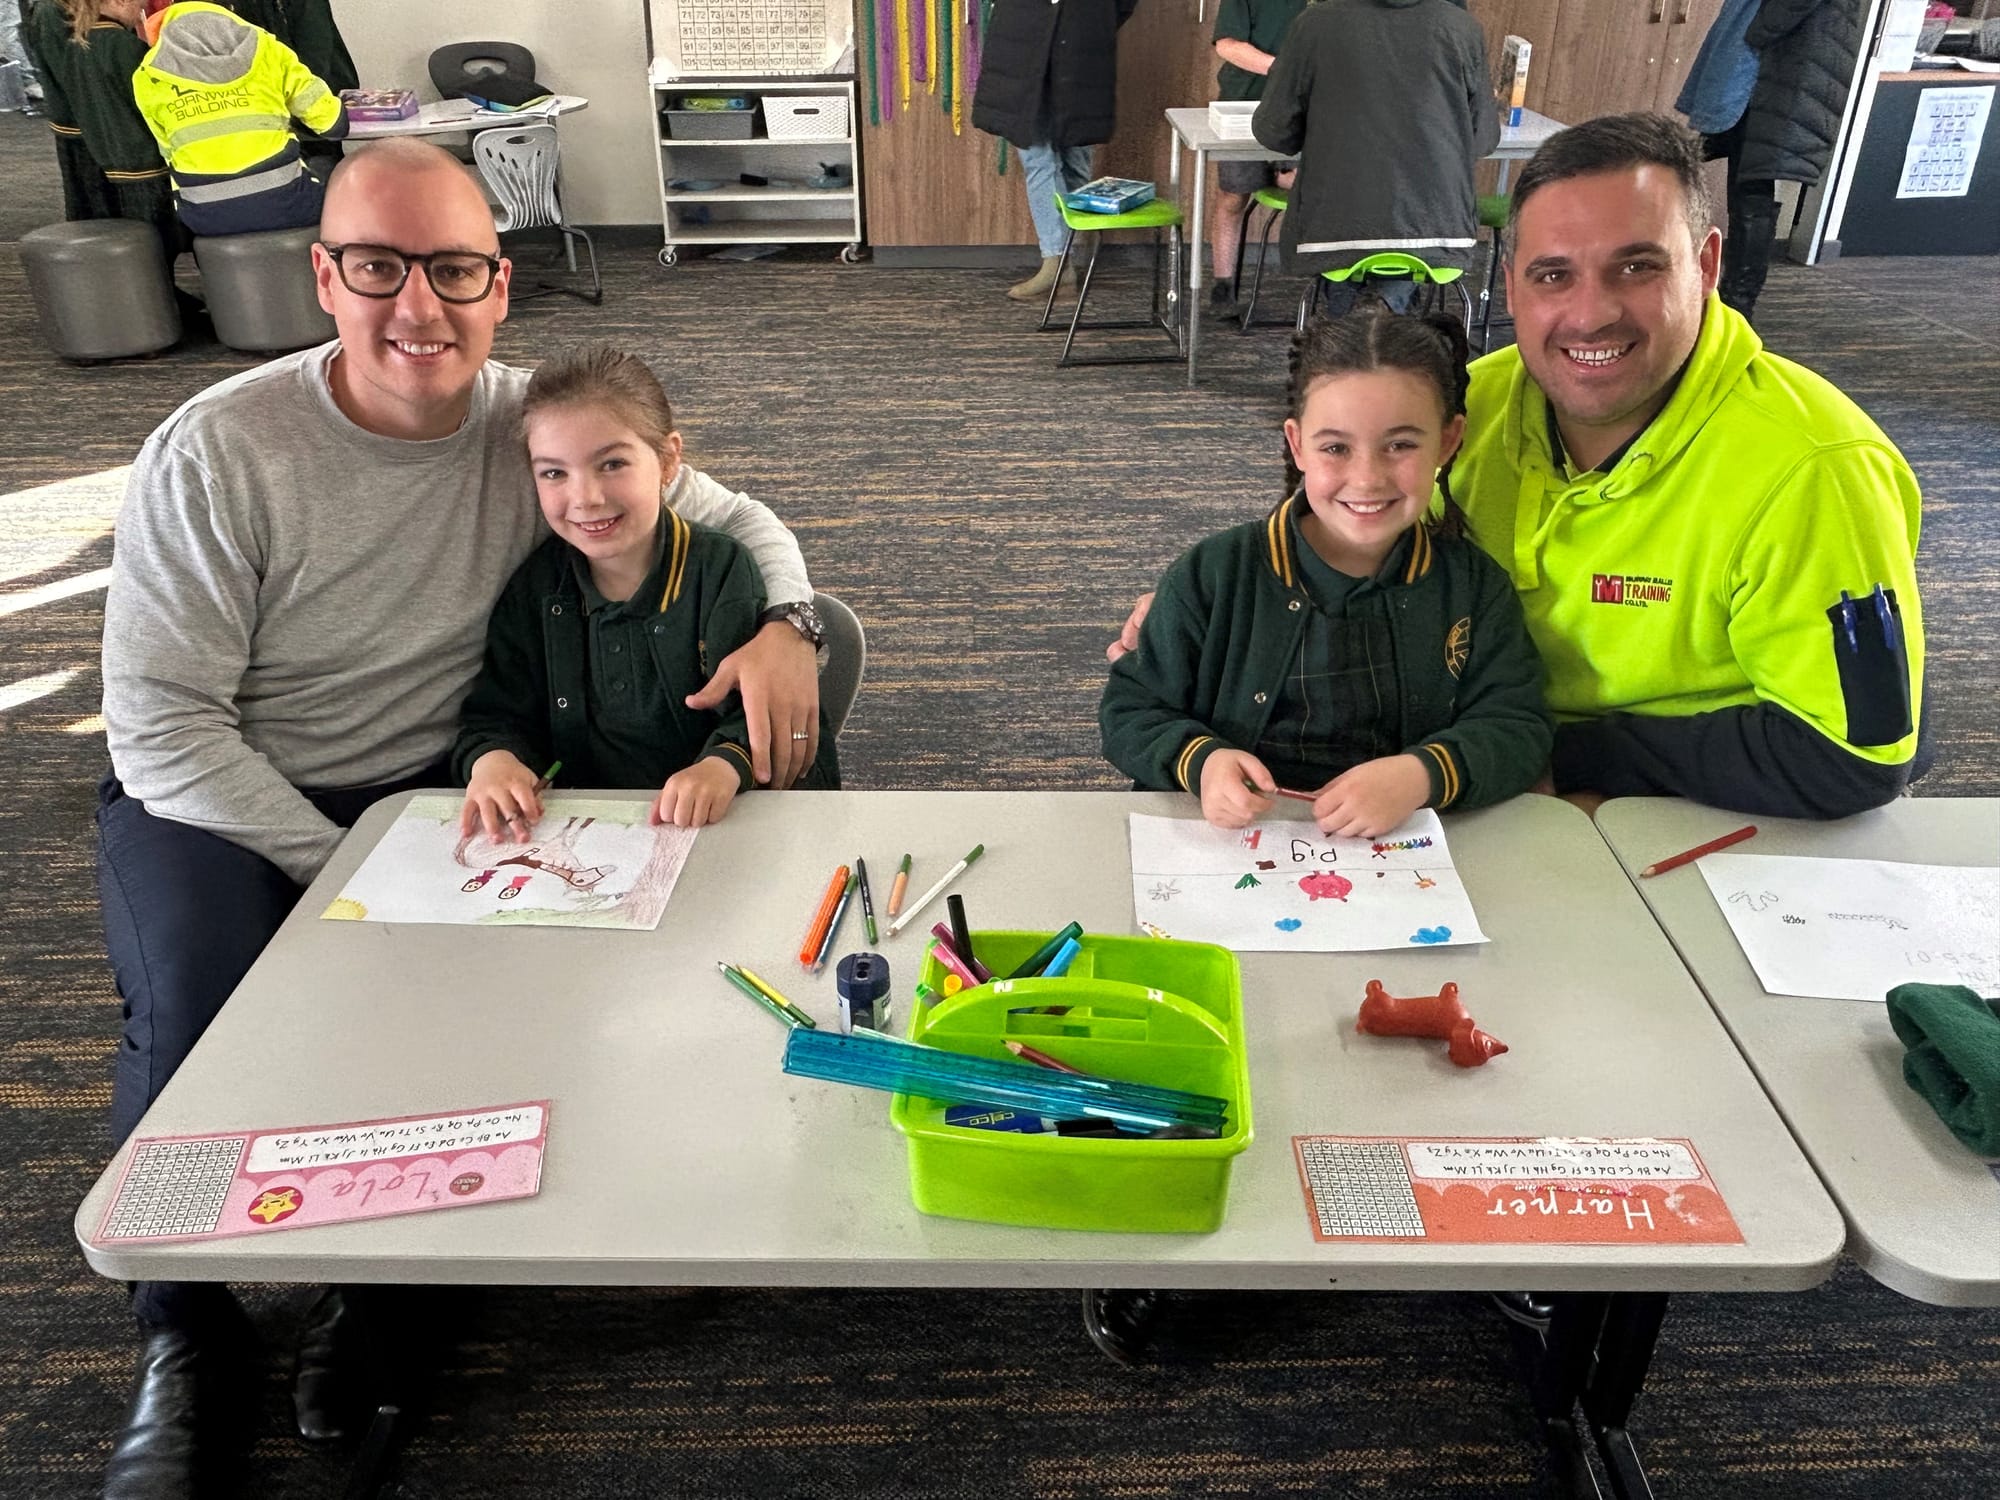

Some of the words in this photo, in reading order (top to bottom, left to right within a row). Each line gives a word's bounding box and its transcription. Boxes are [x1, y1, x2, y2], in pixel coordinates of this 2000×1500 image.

[167, 87, 255, 113] CORNWALL
[175, 97, 250, 121] BUILDING
[1625, 583, 1672, 602] TRAINING
[331, 1172, 431, 1207] Lola
[1487, 1191, 1655, 1231] Harper
